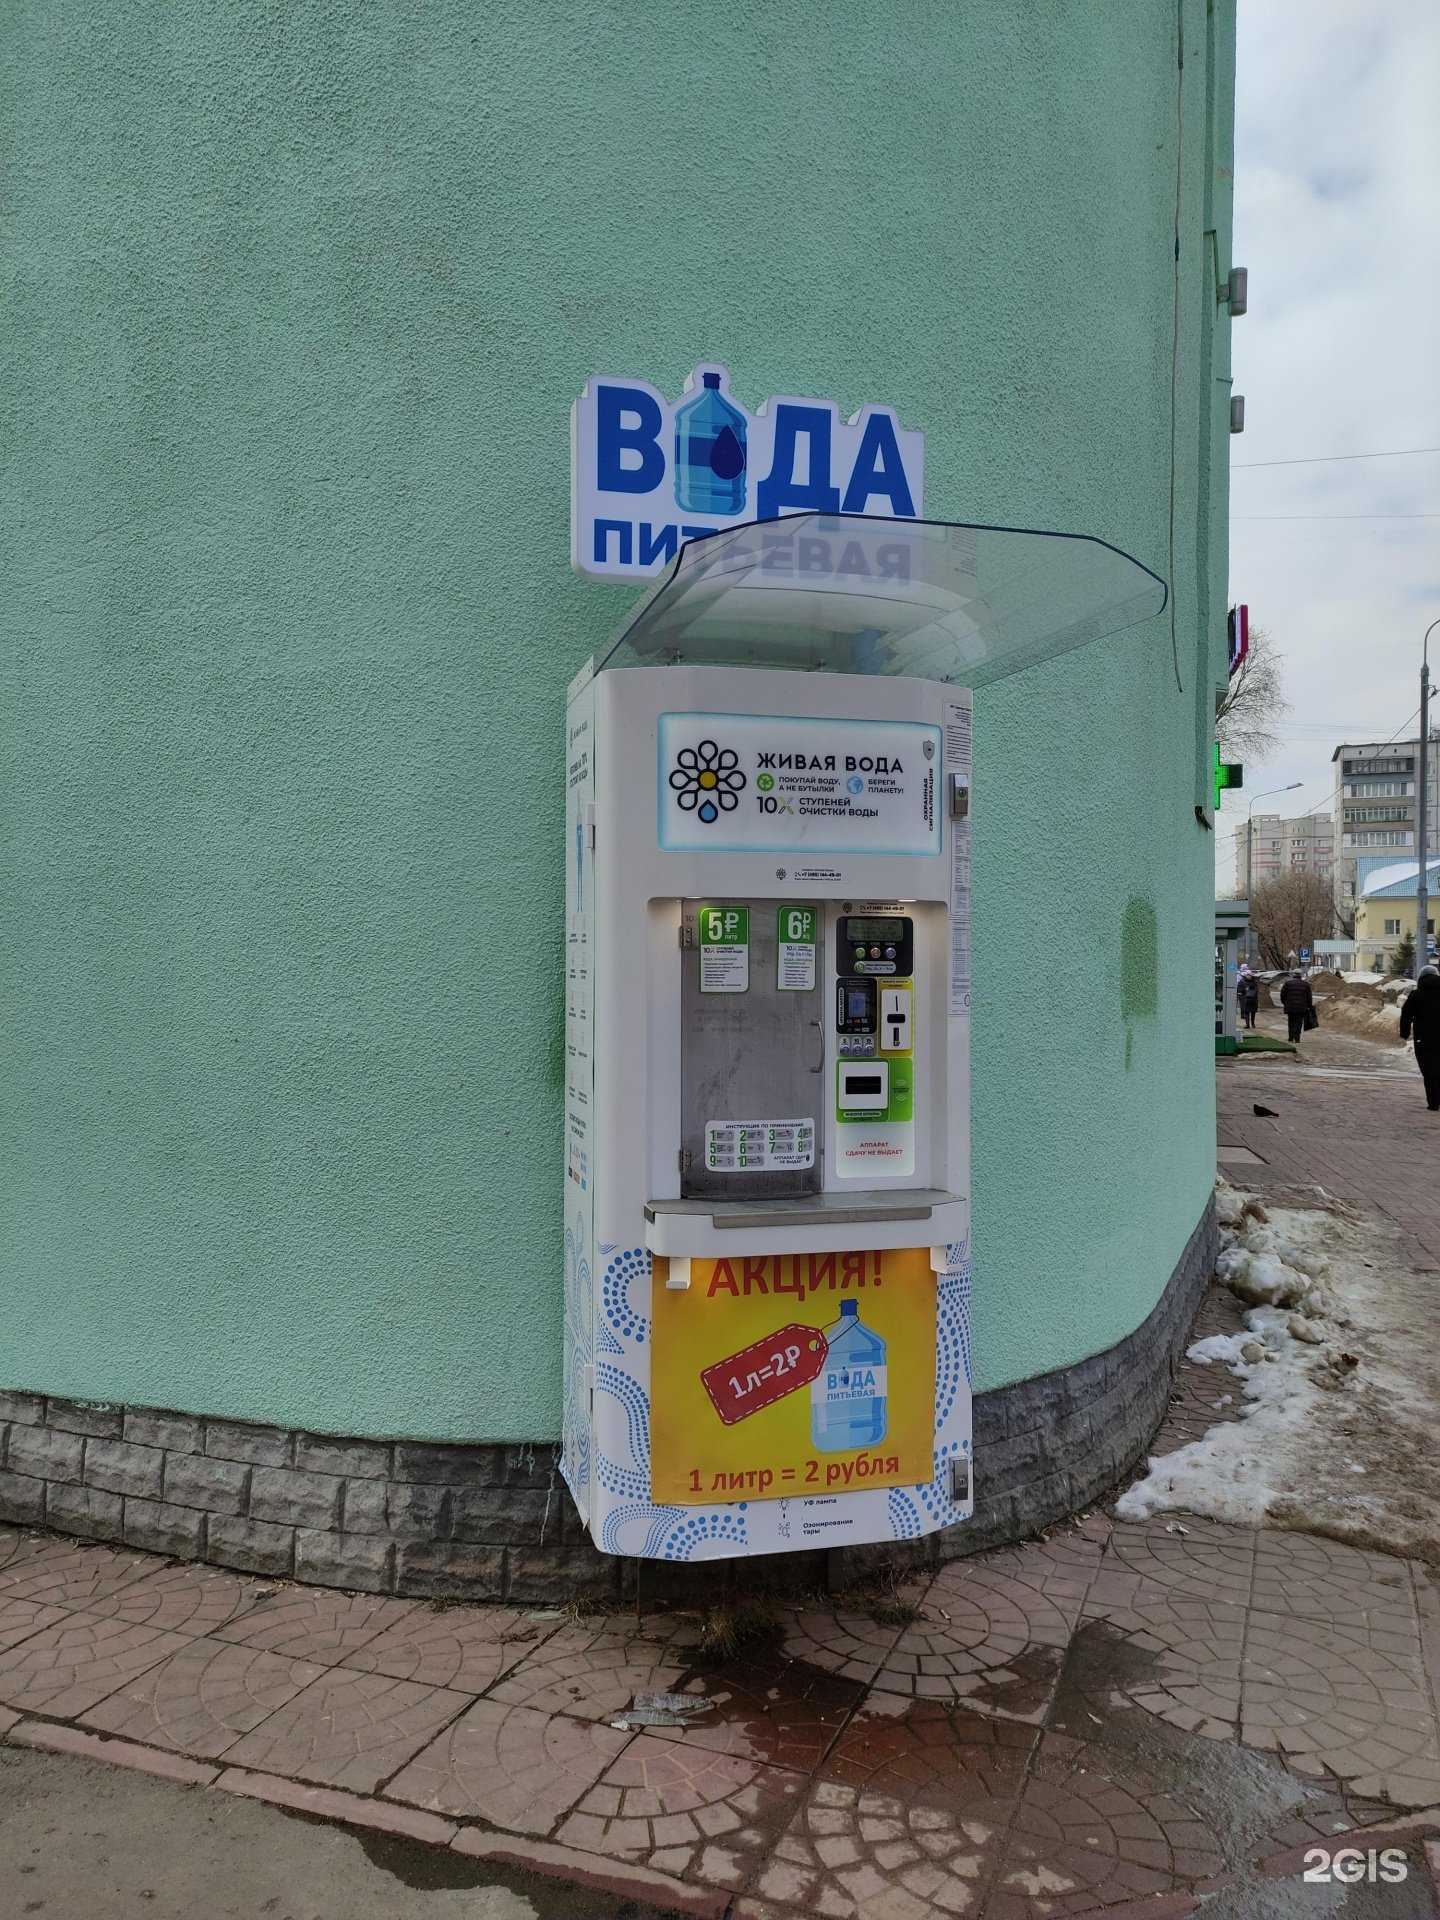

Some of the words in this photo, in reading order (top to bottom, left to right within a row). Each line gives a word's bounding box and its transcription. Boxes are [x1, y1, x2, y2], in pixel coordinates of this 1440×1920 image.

[757, 753, 835, 770] ЖИВАЯ
[846, 756, 904, 774] ВОДА
[779, 776, 816, 785] ПОКУПАЙ
[868, 778, 896, 786] БЕРЕГИ
[798, 785, 835, 793] БУТЫЛКИ
[757, 796, 778, 814] 10
[799, 796, 851, 806] СТУПЕНЕЙ
[799, 807, 846, 816] ОЧИСТКИ
[849, 808, 879, 817] ВОДЫ
[706, 1250, 882, 1302] АКЦИЯ!
[827, 1389, 876, 1400] ПИТЬЕВАЯ
[689, 1468, 703, 1492] 1
[711, 1467, 774, 1492] литр
[805, 1460, 819, 1482] 2
[826, 1452, 900, 1486] рубля
[803, 1519, 853, 1528] Озонирование
